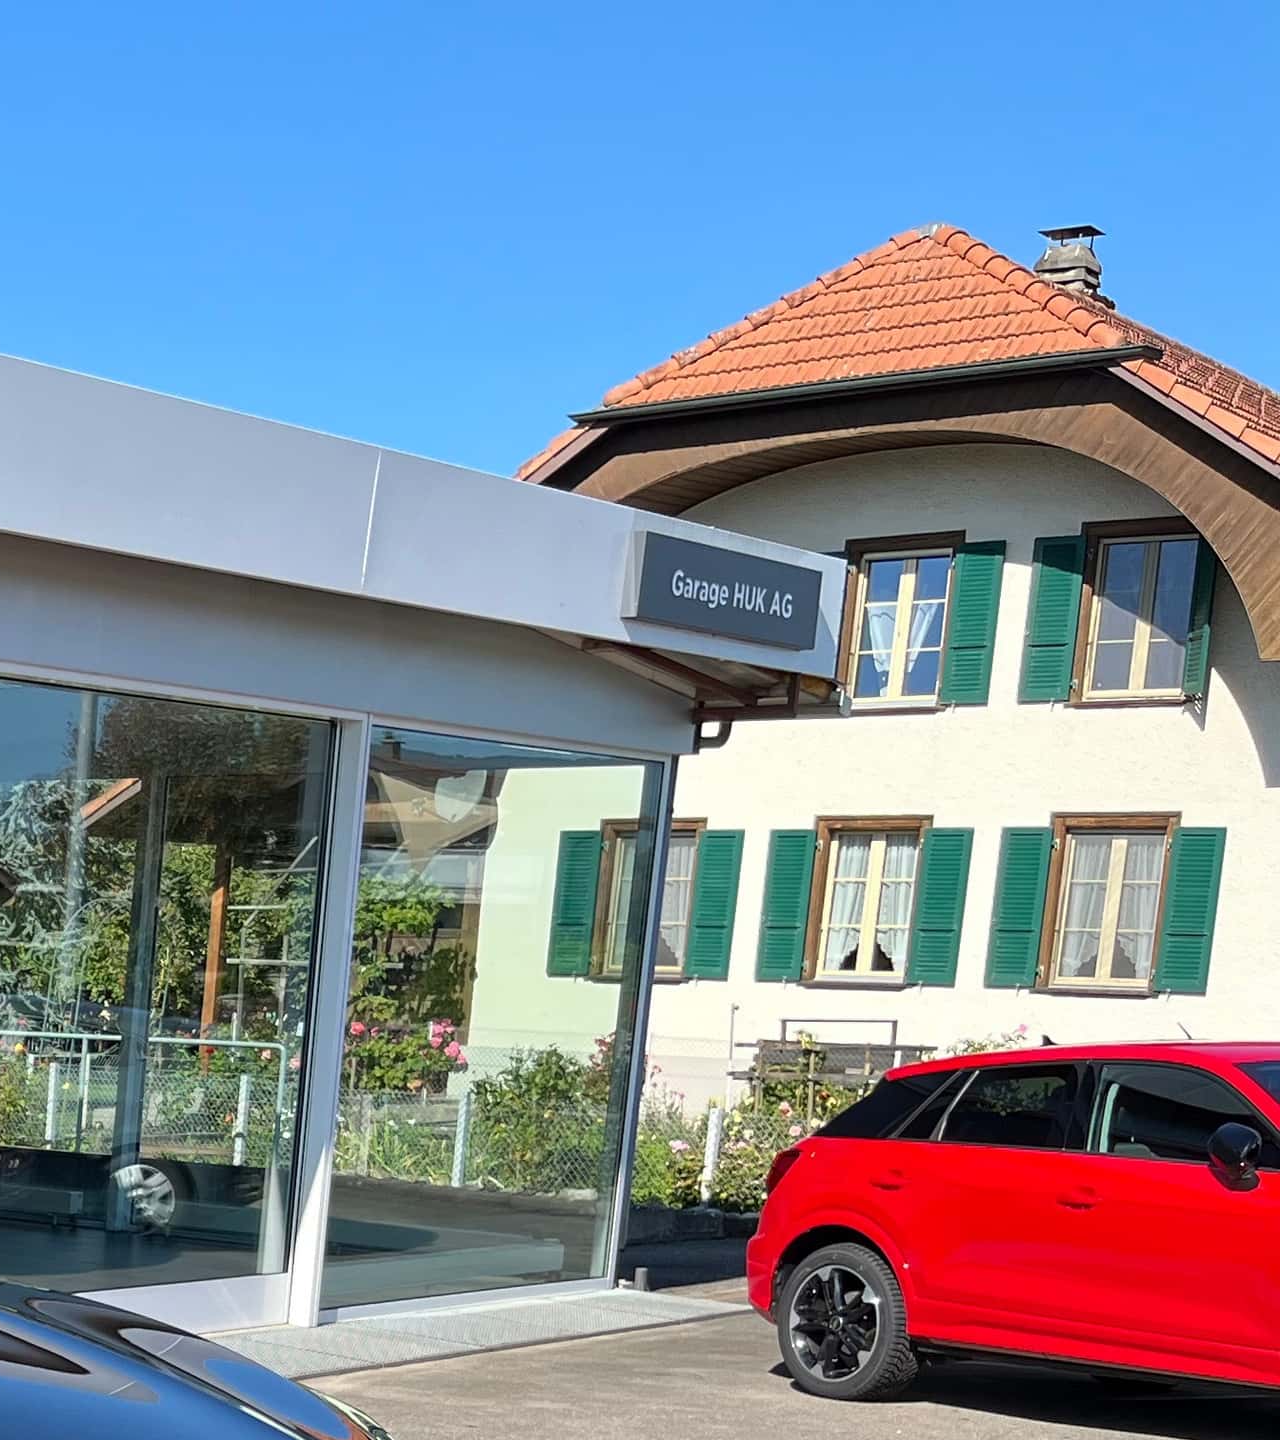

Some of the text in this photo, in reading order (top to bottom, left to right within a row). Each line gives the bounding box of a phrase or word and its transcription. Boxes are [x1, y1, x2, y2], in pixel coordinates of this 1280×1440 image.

[671, 569, 793, 619] Garage HUK AG
